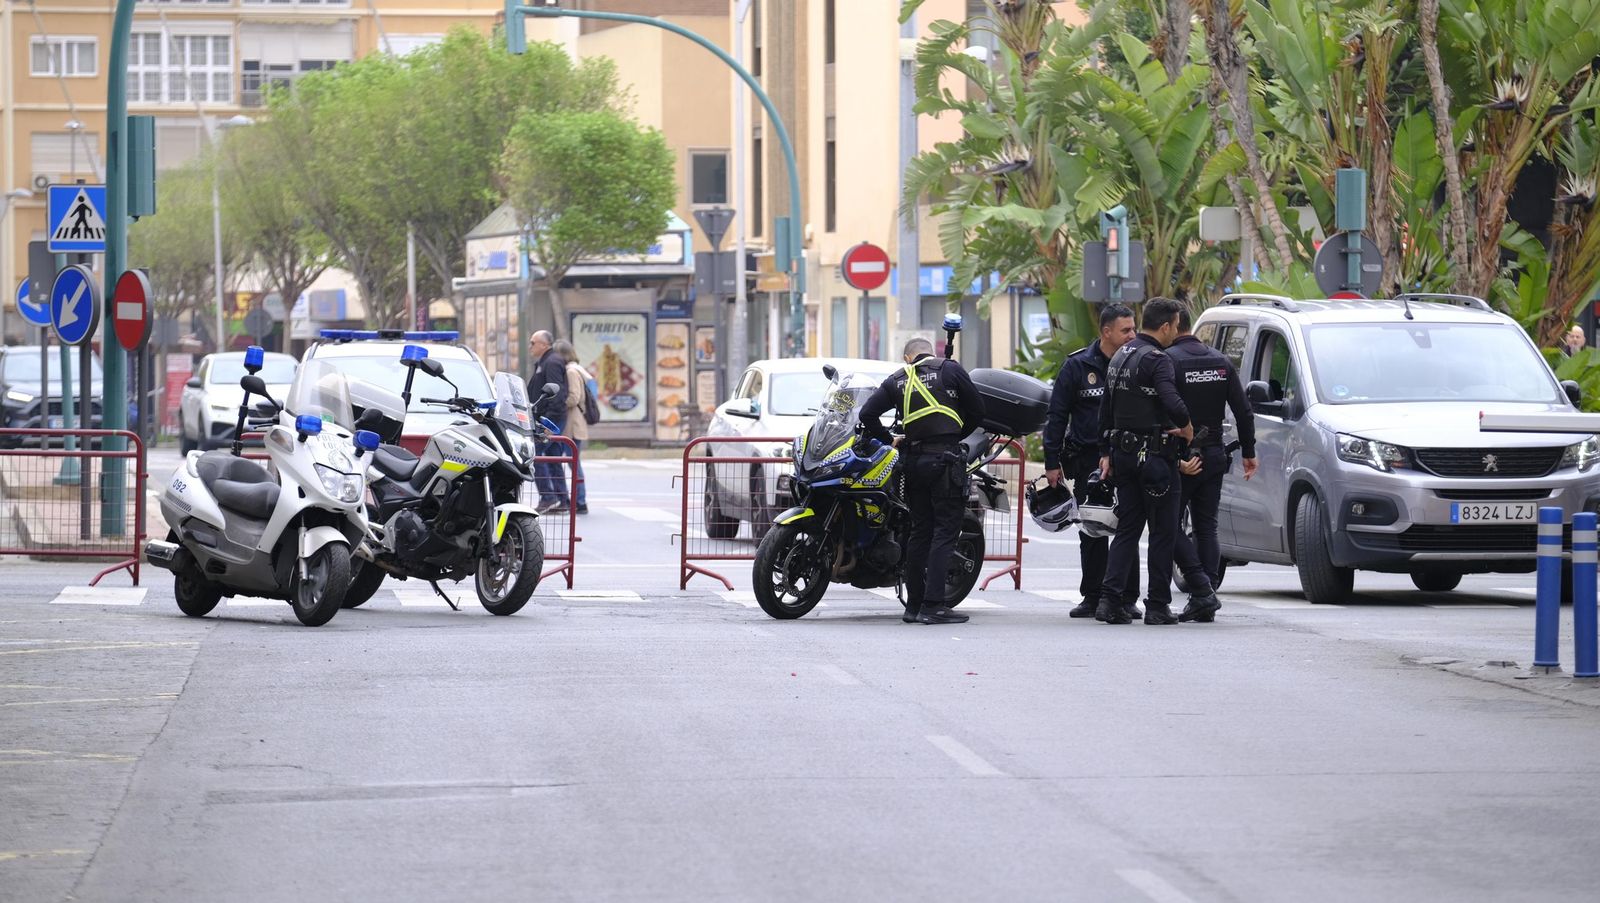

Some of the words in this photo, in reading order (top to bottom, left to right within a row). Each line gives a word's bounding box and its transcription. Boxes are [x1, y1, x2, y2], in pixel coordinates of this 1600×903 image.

[580, 322, 639, 333] PERRITOS
[1185, 370, 1219, 378] POLICIA
[1186, 375, 1227, 383] NACIONAL
[172, 478, 187, 493] 092
[1462, 506, 1500, 520] 8324
[1505, 506, 1533, 520] LZJ
